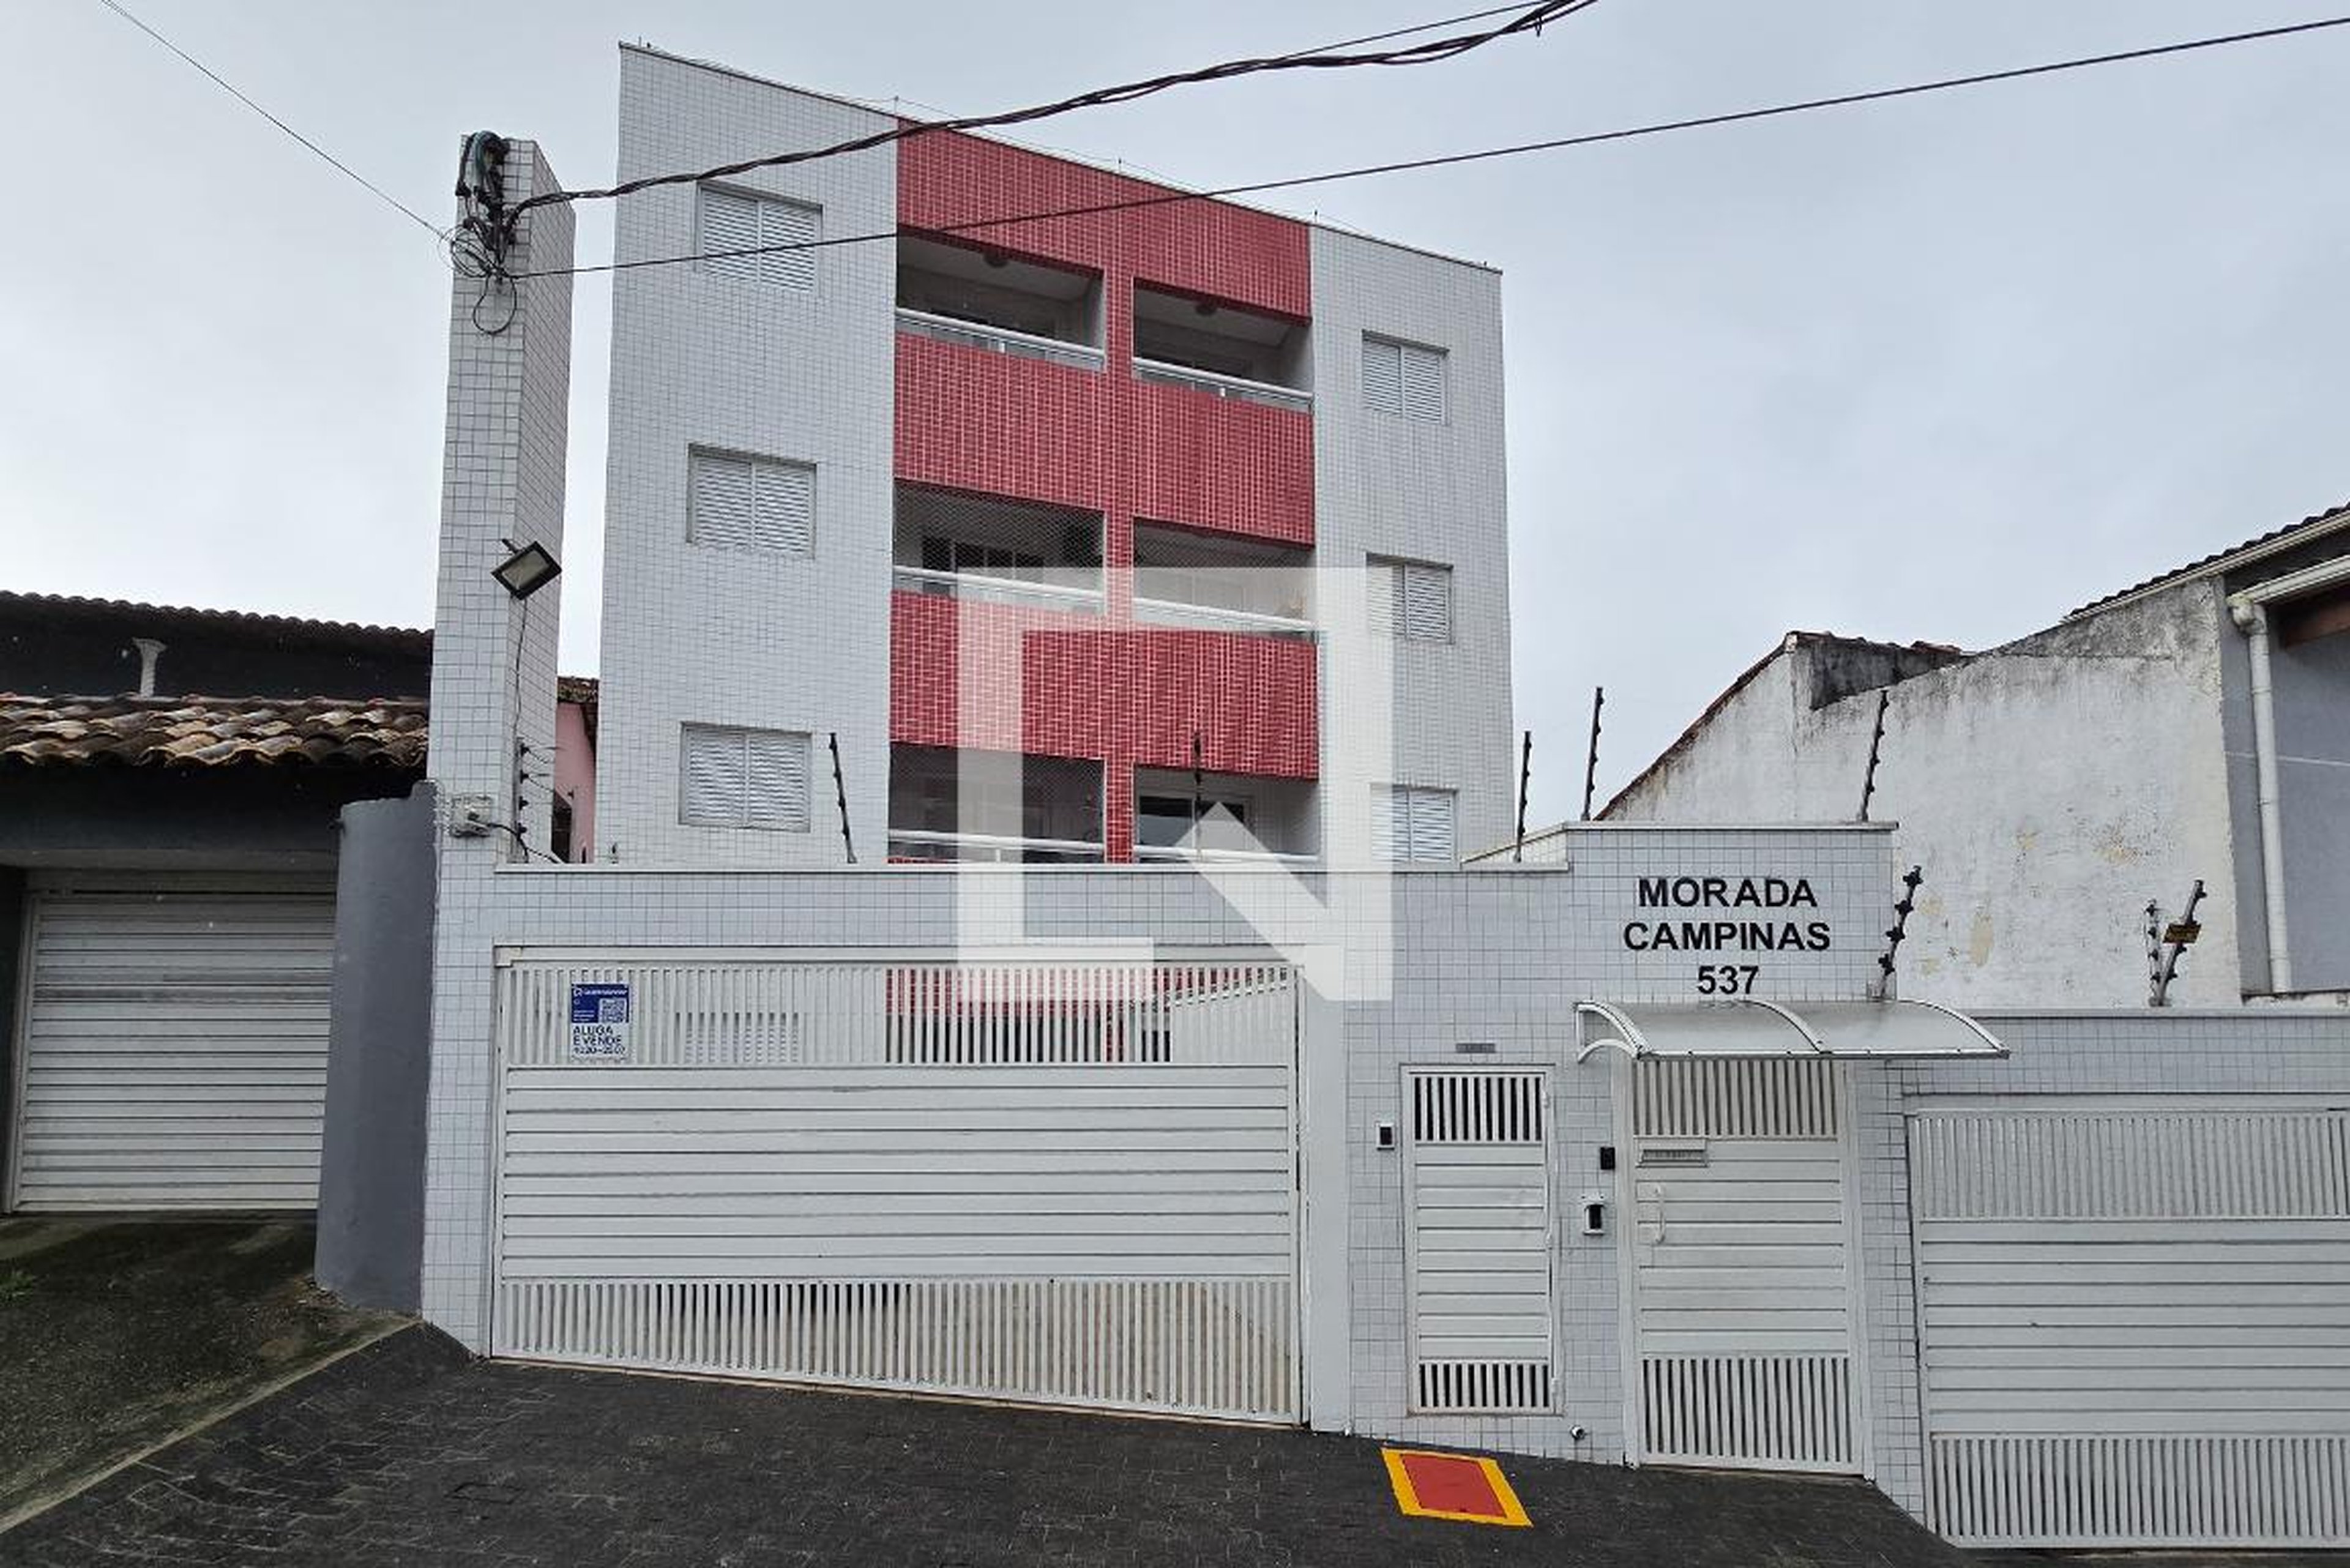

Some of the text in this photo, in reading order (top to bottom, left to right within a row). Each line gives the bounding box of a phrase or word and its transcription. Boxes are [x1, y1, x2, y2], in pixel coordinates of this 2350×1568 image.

[1638, 877, 1818, 908] MORADA
[1624, 922, 1830, 951] CAMPINAS
[1697, 965, 1759, 995] 537
[573, 1025, 613, 1036] ALUGA
[573, 1034, 622, 1045] E VENDE
